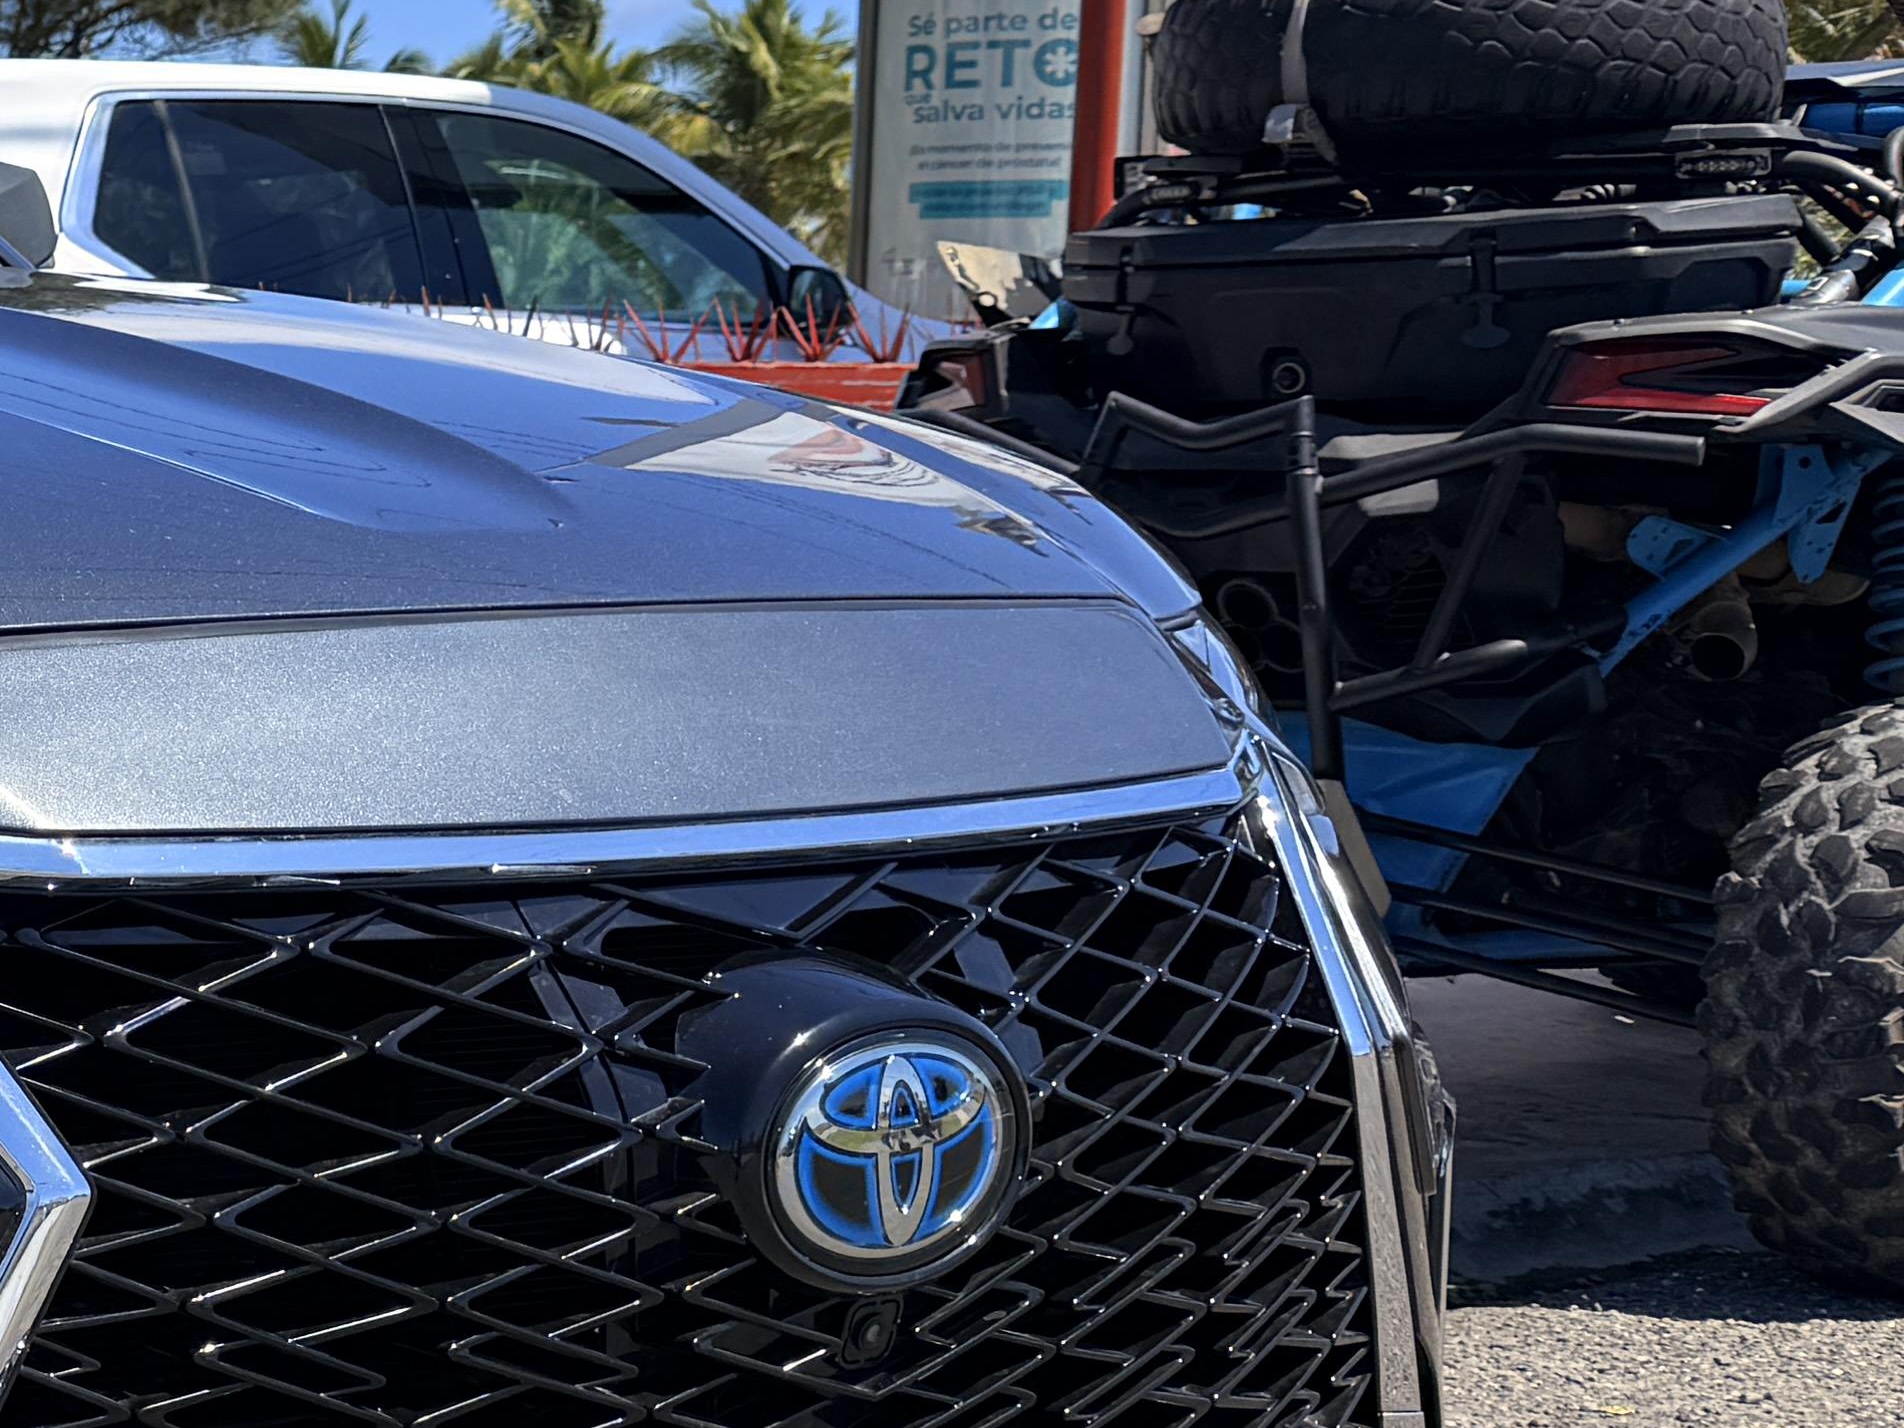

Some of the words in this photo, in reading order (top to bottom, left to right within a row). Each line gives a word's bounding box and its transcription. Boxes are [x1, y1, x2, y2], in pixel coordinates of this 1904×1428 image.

[944, 12, 1028, 39] parte
[1038, 6, 1078, 31] de
[904, 38, 1078, 92] RETO
[914, 100, 985, 123] salva
